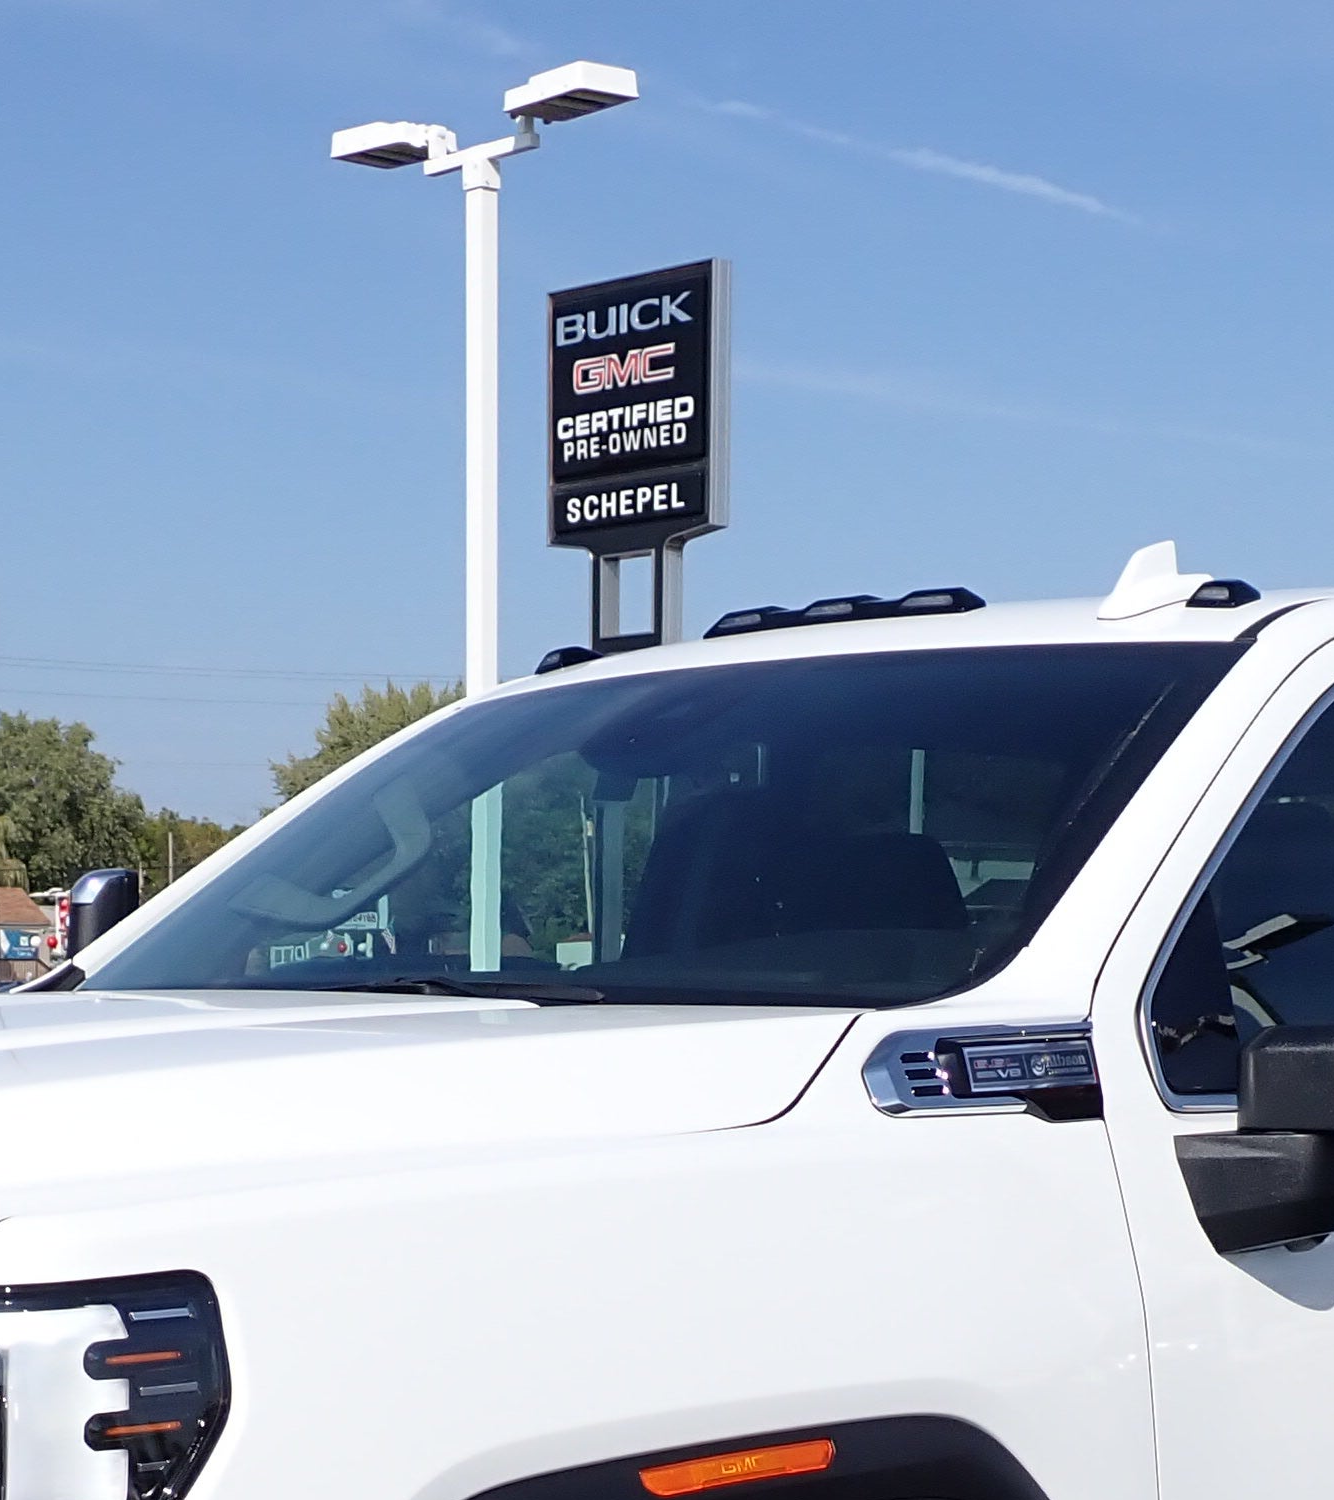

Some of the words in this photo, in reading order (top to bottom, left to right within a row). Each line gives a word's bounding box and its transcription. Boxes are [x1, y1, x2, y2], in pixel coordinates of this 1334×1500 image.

[556, 291, 693, 347] BUICK
[573, 343, 675, 395] GMC
[557, 395, 694, 440] CERTIFIED
[563, 422, 687, 462] PRE-OWNED
[566, 483, 685, 524] SCHEPEL
